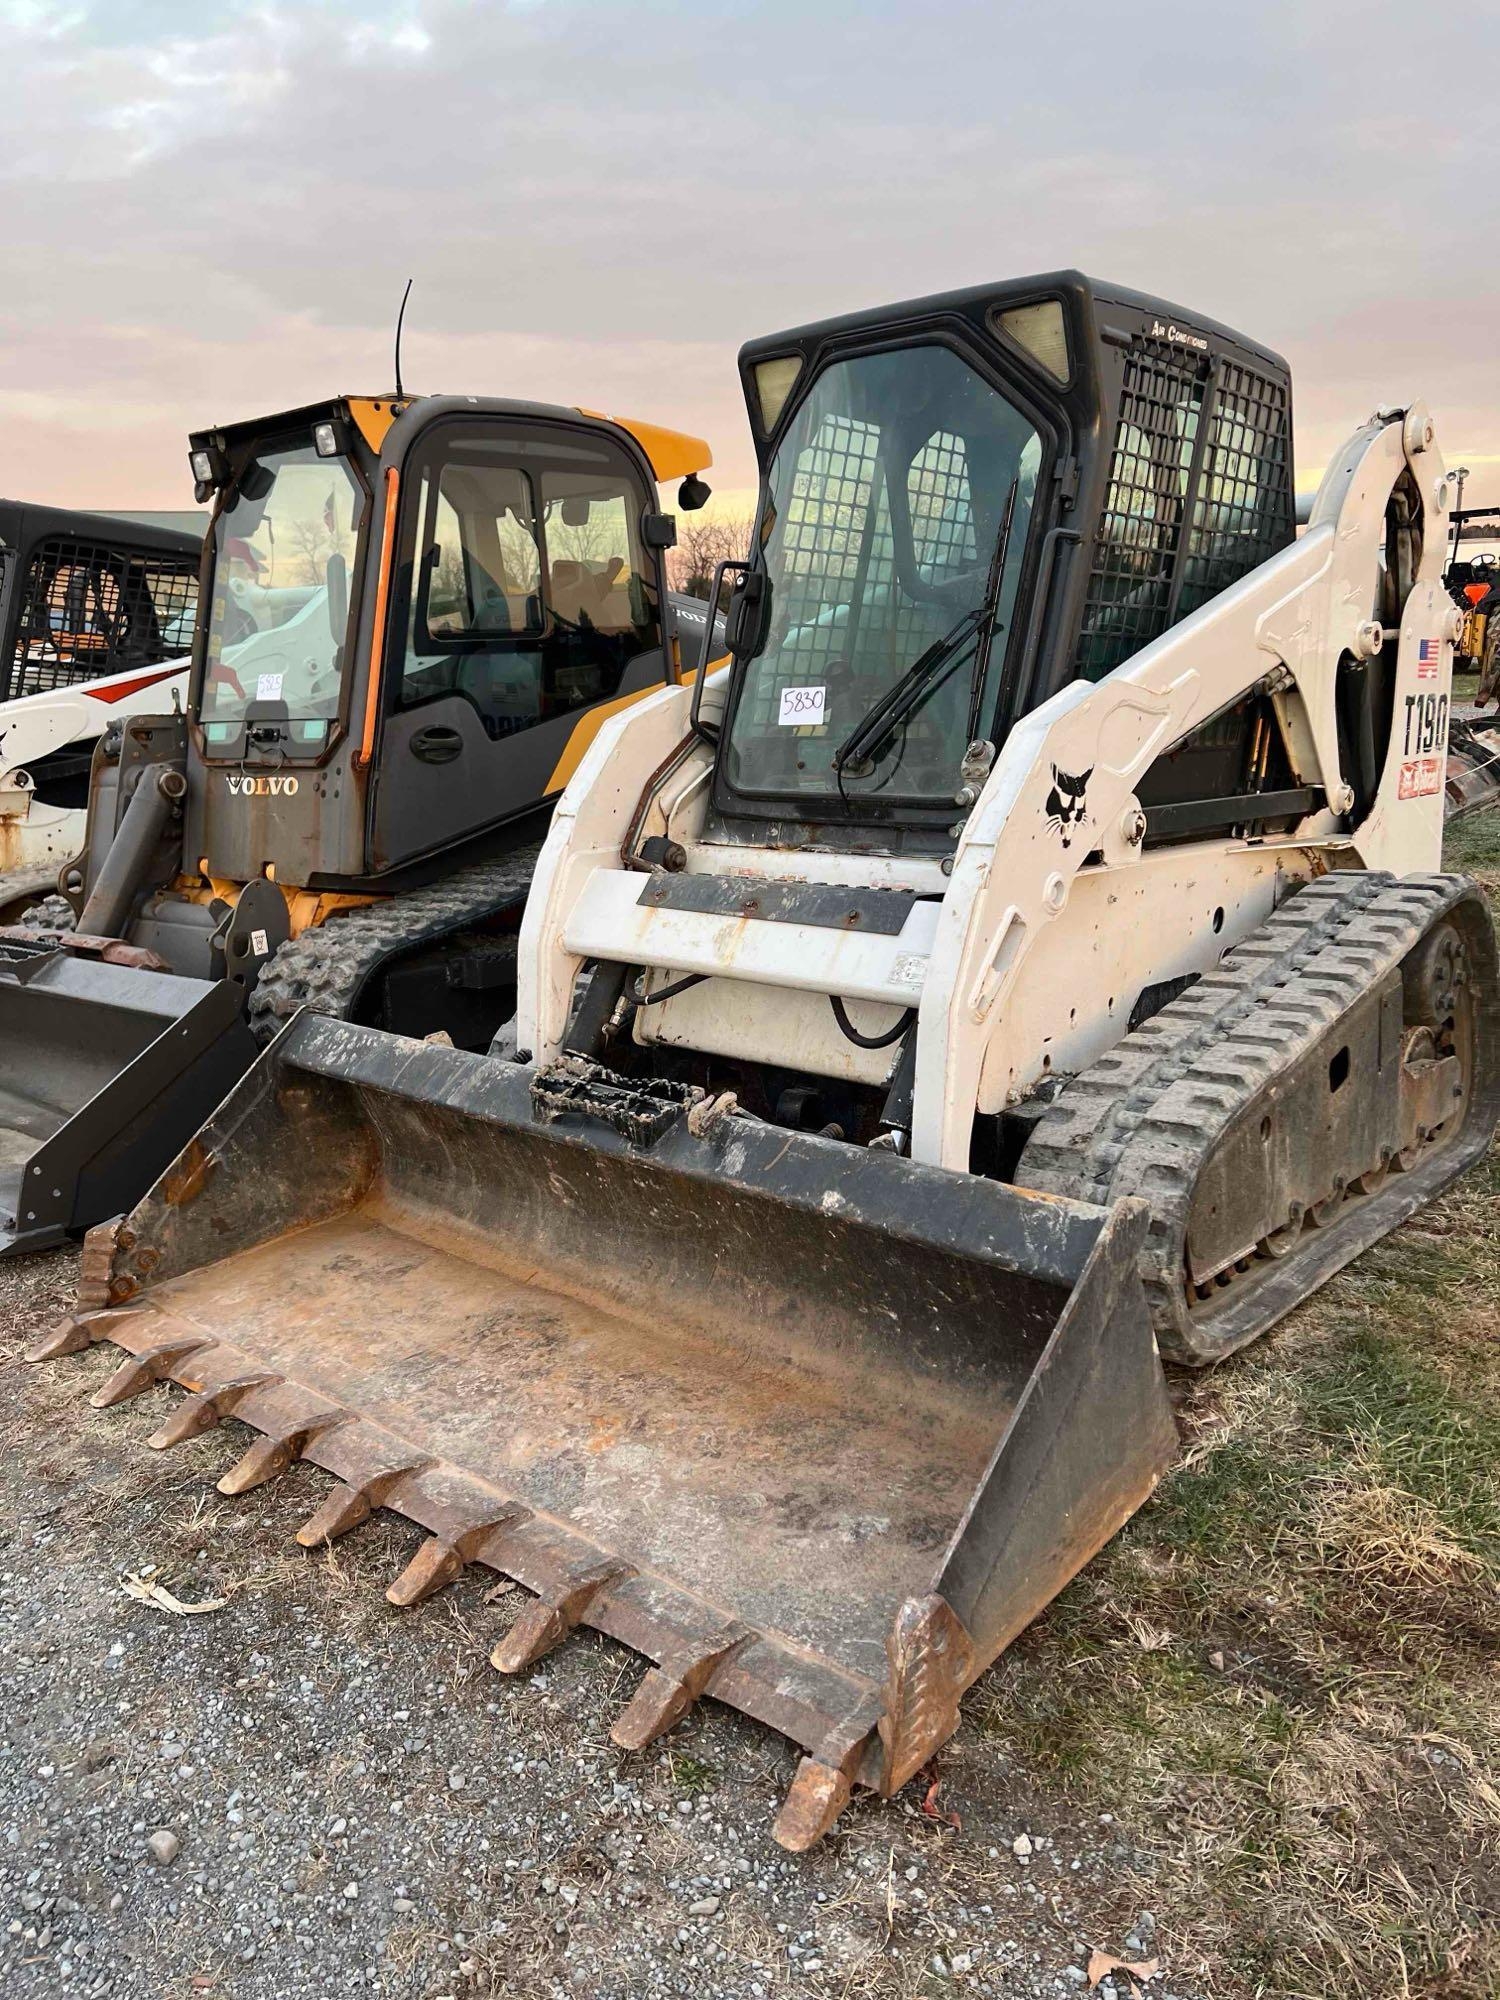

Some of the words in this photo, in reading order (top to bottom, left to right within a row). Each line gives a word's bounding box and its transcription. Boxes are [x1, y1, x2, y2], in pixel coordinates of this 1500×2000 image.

[1151, 320, 1166, 336] AIR
[784, 690, 824, 715] 5830
[1404, 693, 1448, 756] T190
[226, 776, 299, 796] VOLVO
